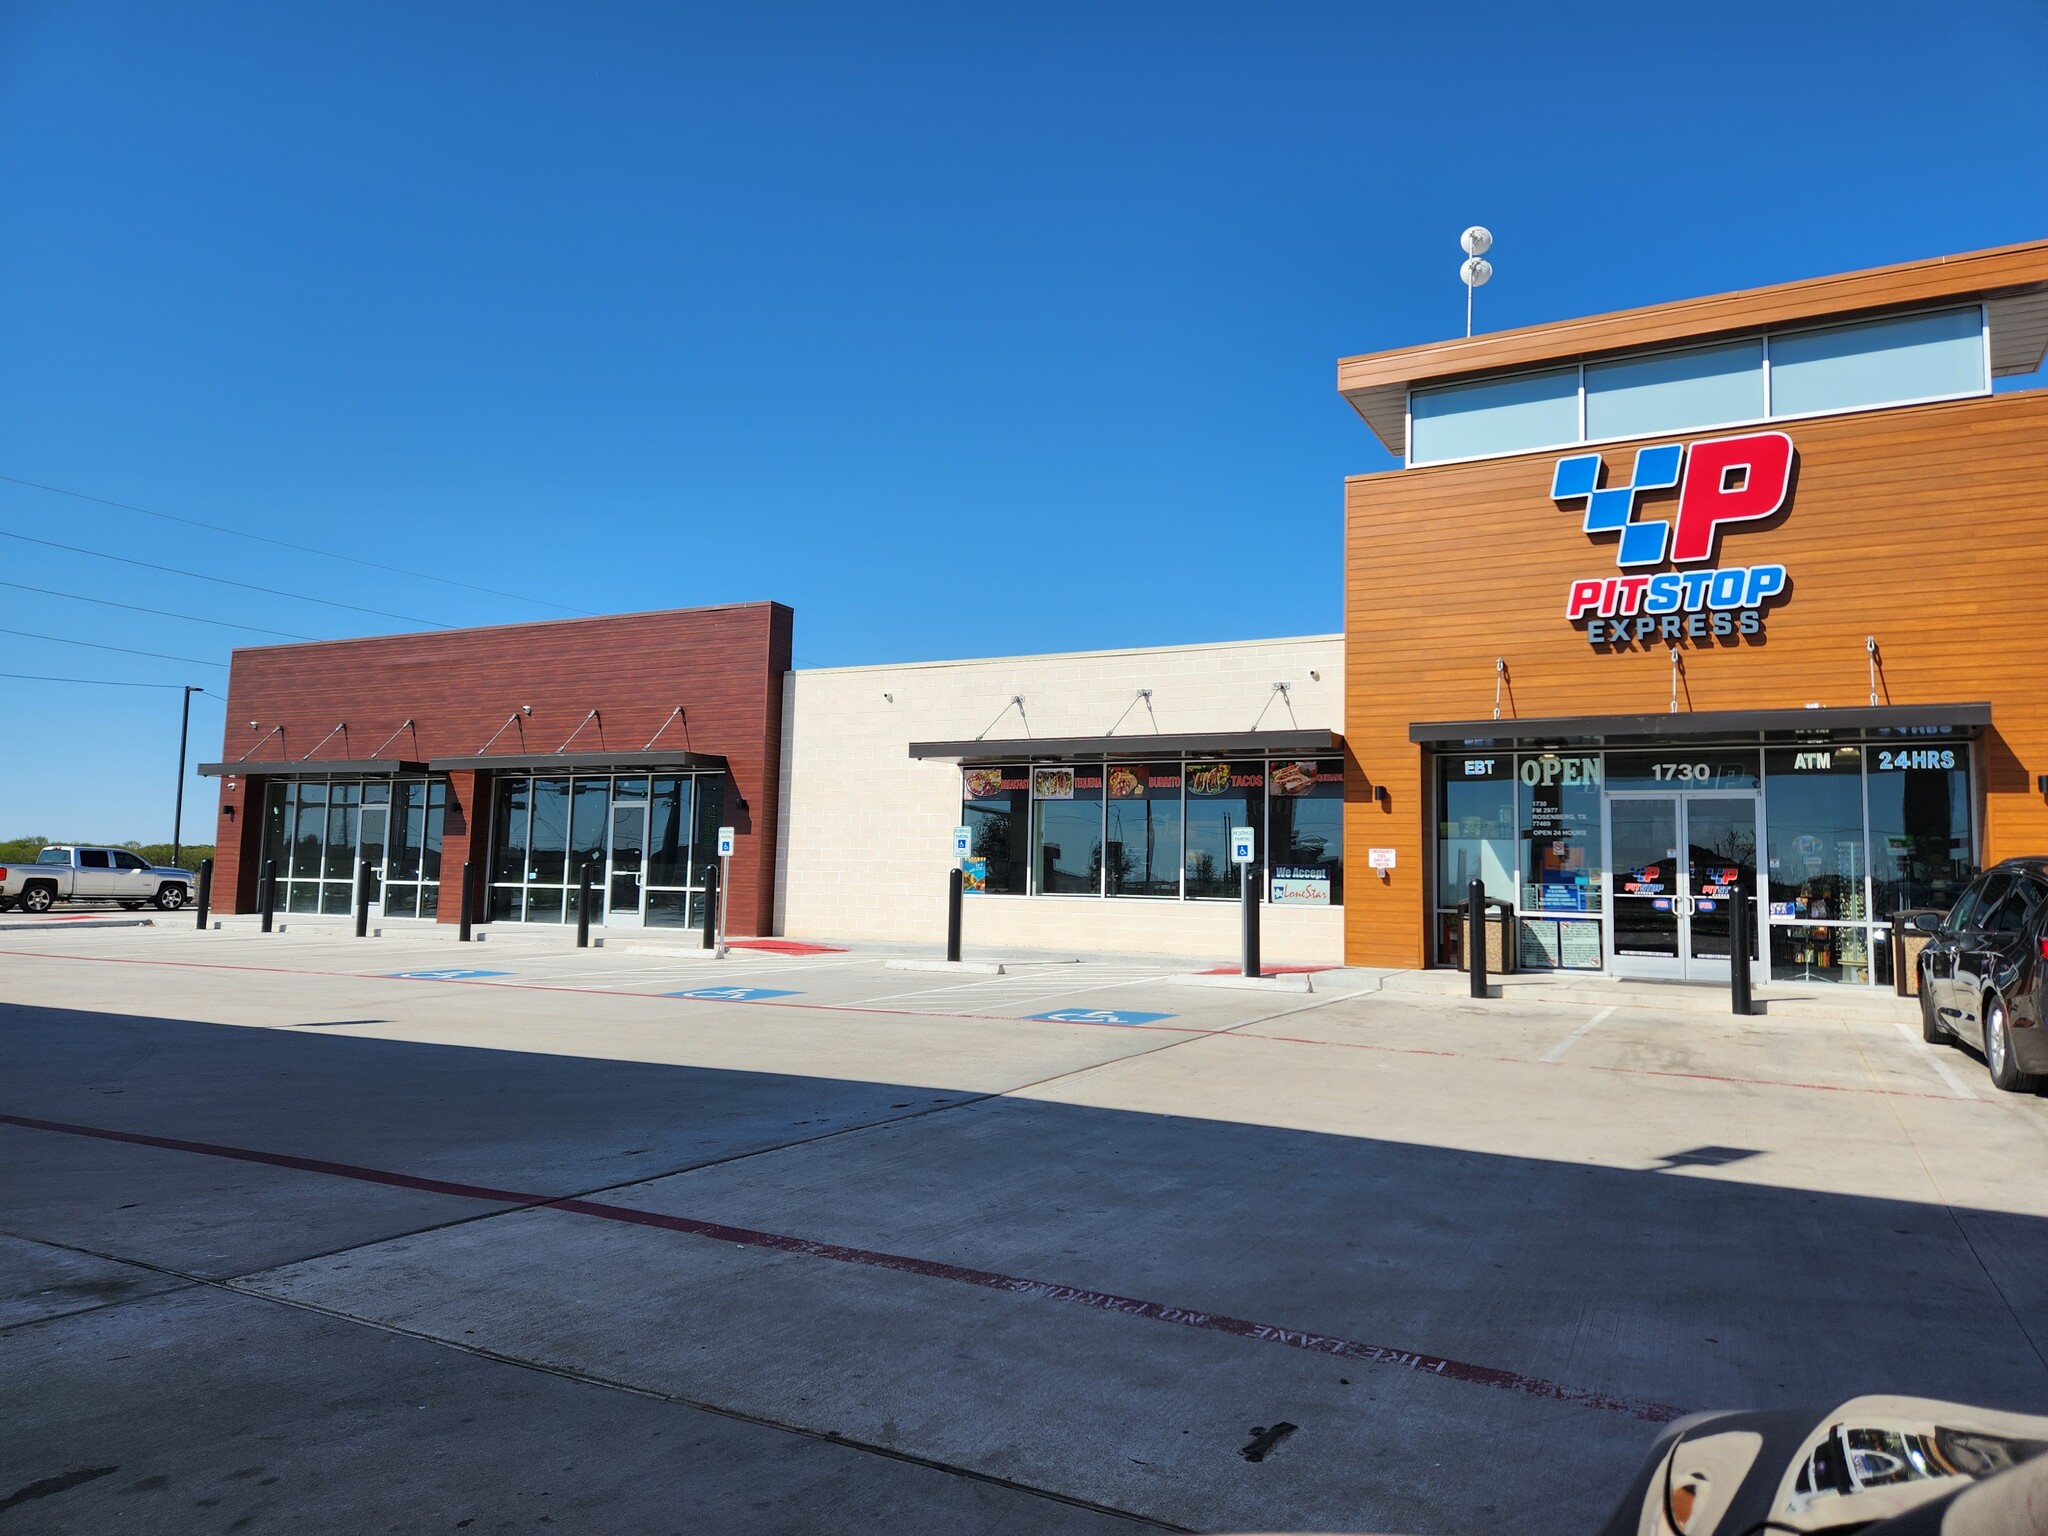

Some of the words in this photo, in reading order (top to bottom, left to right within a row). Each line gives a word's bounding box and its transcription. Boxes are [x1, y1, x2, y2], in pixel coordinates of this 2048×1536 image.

[1670, 431, 1793, 562] P
[1566, 564, 1786, 620] PITSTOP
[1587, 610, 1760, 643] EXPRESS
[1464, 759, 1496, 776] EBT
[1793, 752, 1831, 770] ATM
[1878, 750, 1955, 770] 24HRS
[1231, 774, 1264, 787] TACOS
[1520, 757, 1600, 787] OPEN
[1651, 763, 1711, 781] 1730
[1148, 776, 1181, 788] BURRITO
[1275, 866, 1291, 878] We
[1292, 867, 1327, 880] Accept
[1159, 1308, 1208, 1326] NO
[1247, 1324, 1347, 1354] LANE
[1361, 1345, 1447, 1374] FIRE
